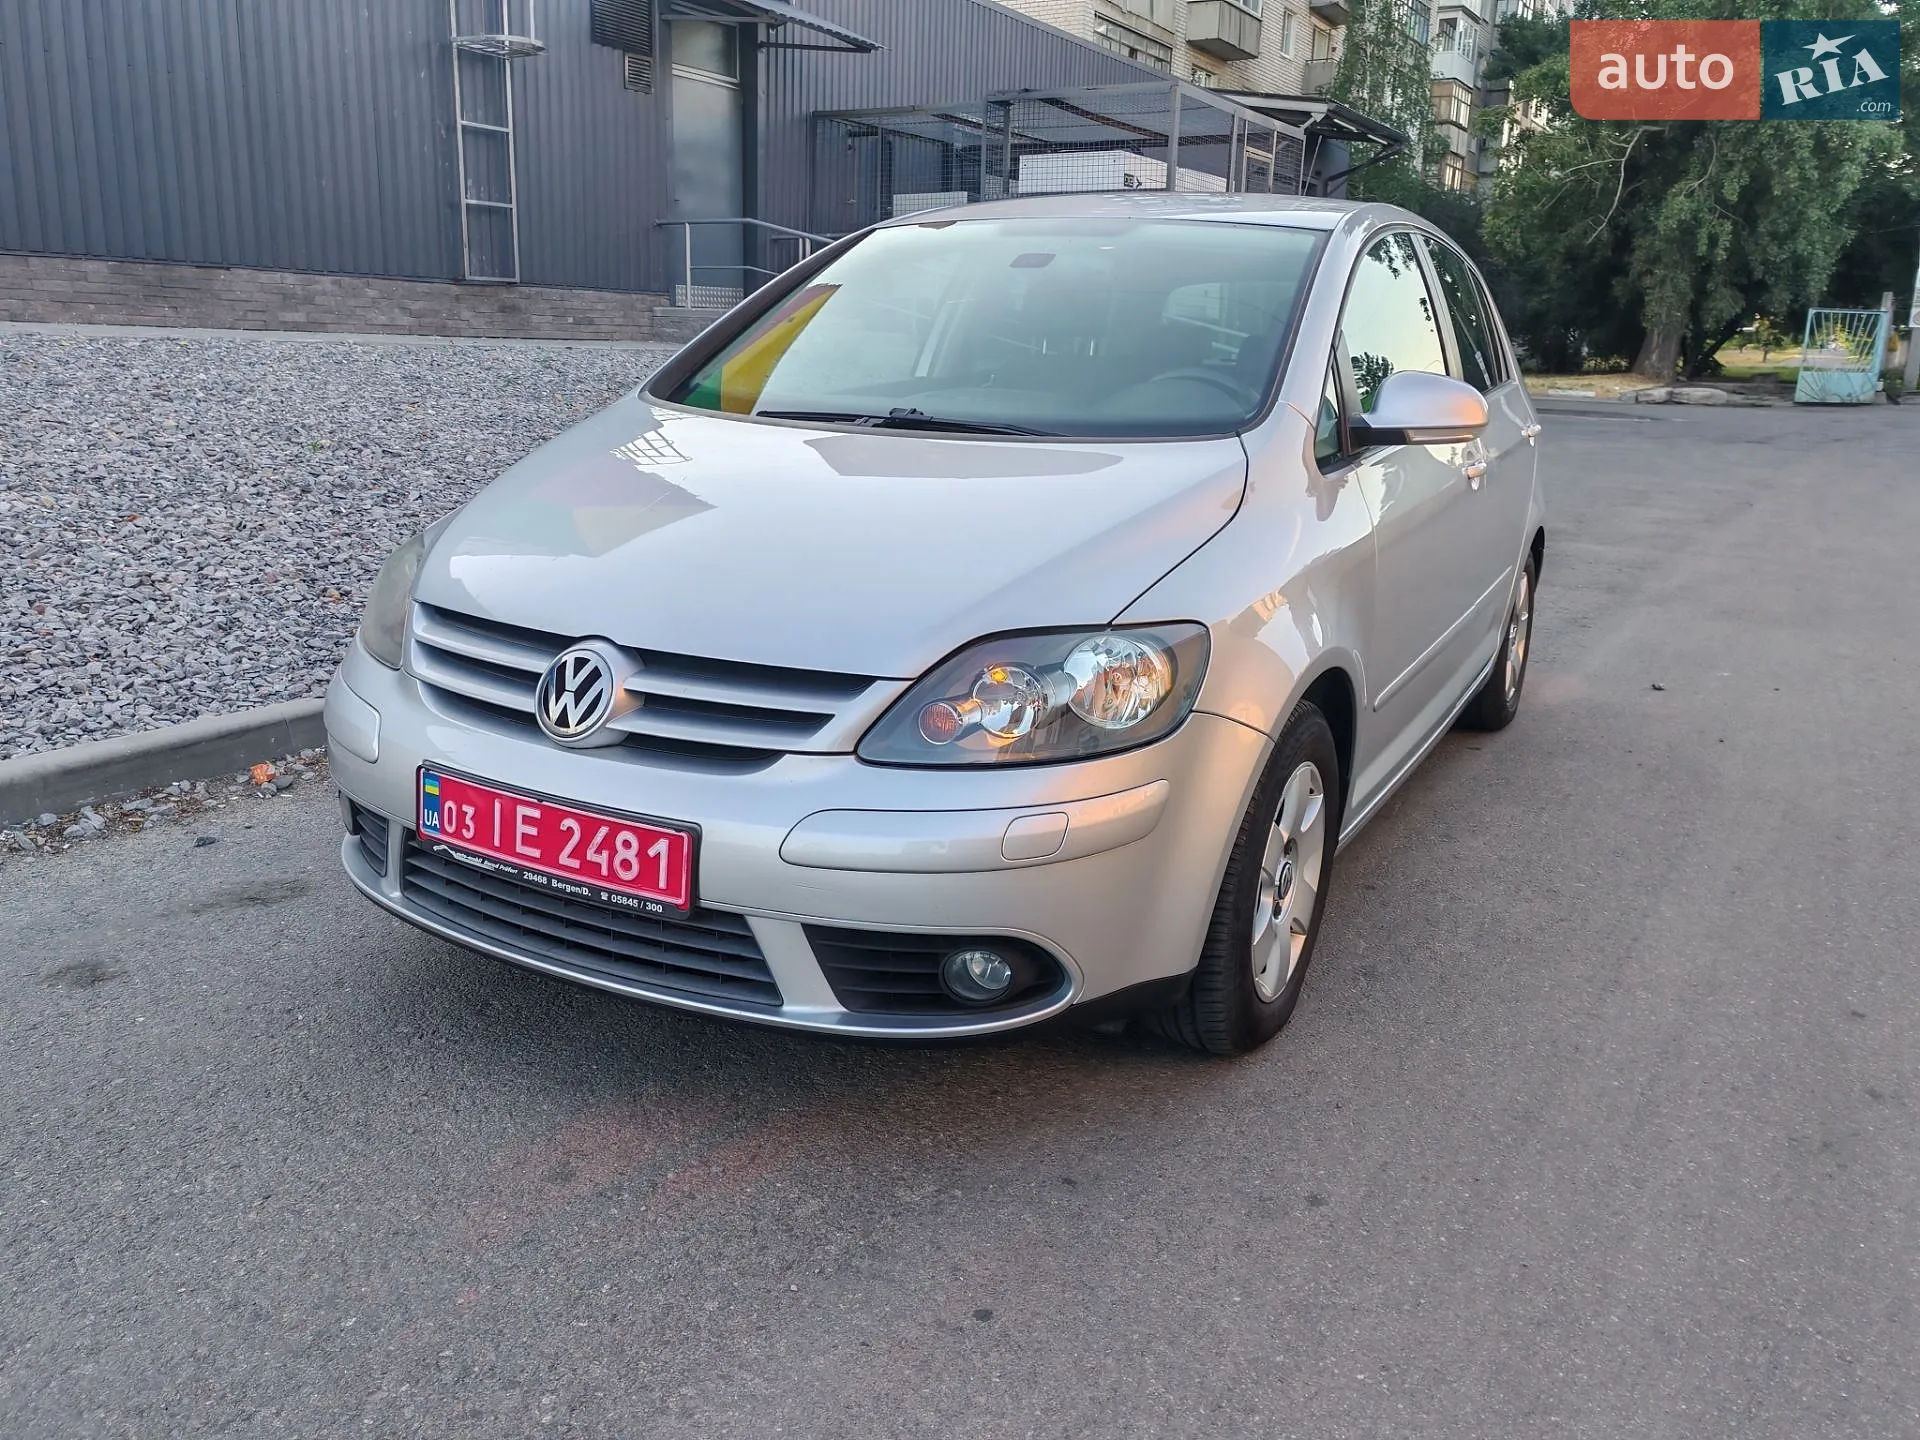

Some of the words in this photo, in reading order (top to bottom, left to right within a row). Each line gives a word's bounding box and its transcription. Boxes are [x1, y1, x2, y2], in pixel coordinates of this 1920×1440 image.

[424, 809, 440, 828] UA
[444, 800, 475, 840] 03
[493, 799, 541, 859] IE
[559, 818, 669, 890] 2481
[523, 871, 548, 885] 29468
[611, 894, 638, 908] 05845
[645, 901, 663, 913] 300
